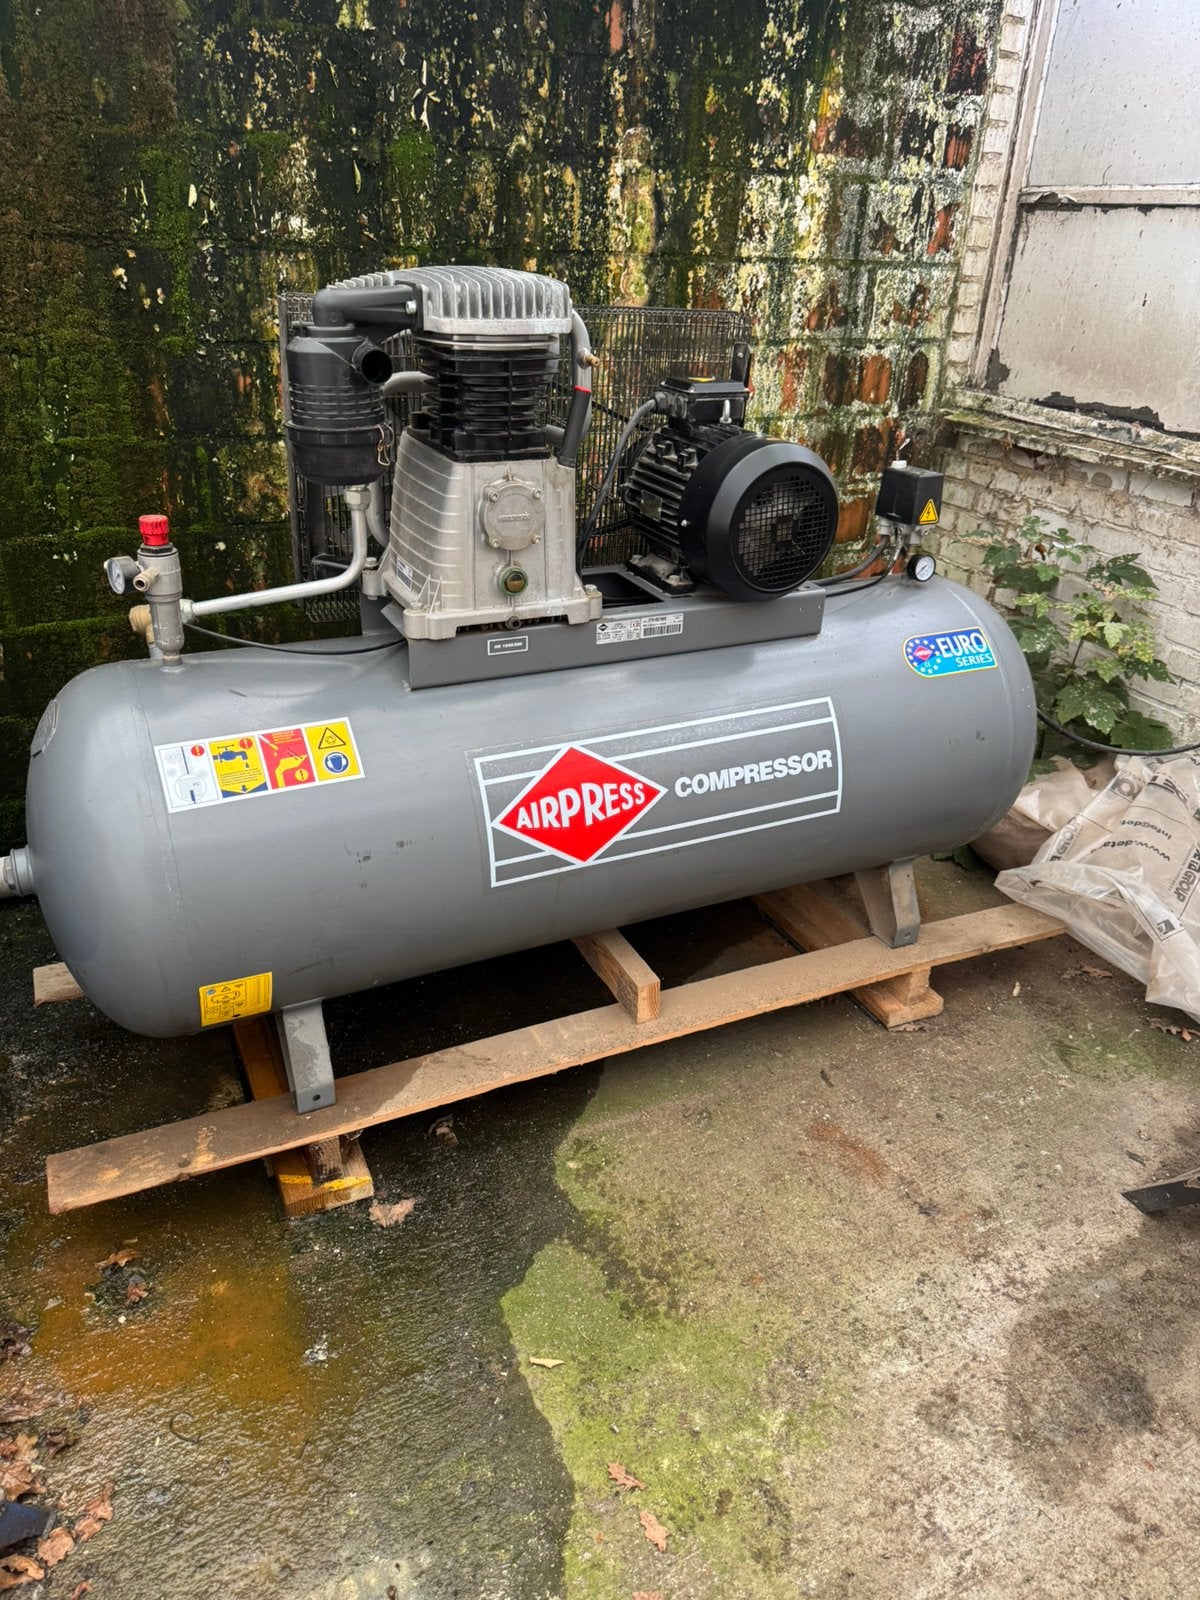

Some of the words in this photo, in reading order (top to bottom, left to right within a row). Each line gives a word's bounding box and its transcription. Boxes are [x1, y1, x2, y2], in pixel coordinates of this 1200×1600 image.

[935, 632, 988, 658] EURO
[955, 653, 993, 668] SERIES
[674, 749, 833, 799] COMPRESSOR
[516, 781, 645, 830] AIRPRESS
[1120, 819, 1172, 840] info@det
